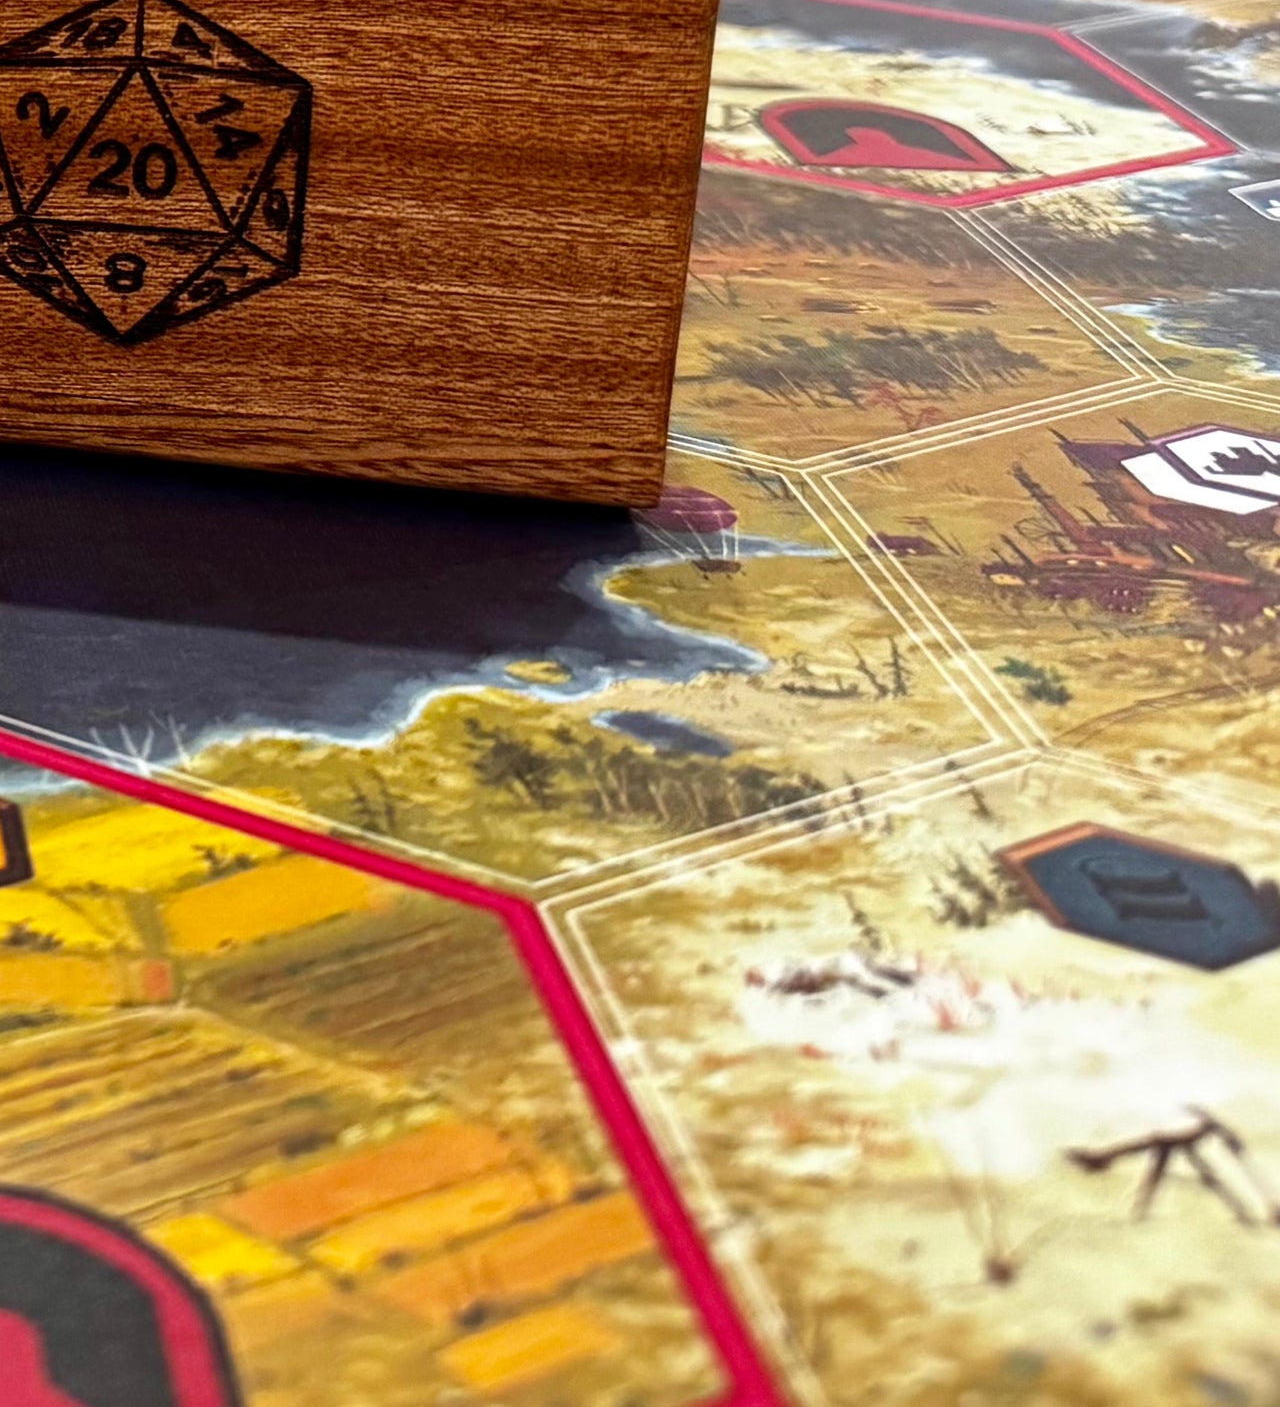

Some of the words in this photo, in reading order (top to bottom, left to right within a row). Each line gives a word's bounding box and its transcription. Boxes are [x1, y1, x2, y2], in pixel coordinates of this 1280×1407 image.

[59, 16, 128, 49] 18
[170, 21, 214, 60] 4
[15, 90, 72, 140] 2
[194, 93, 263, 161] 14
[87, 138, 179, 200] 20
[103, 251, 148, 294] 8
